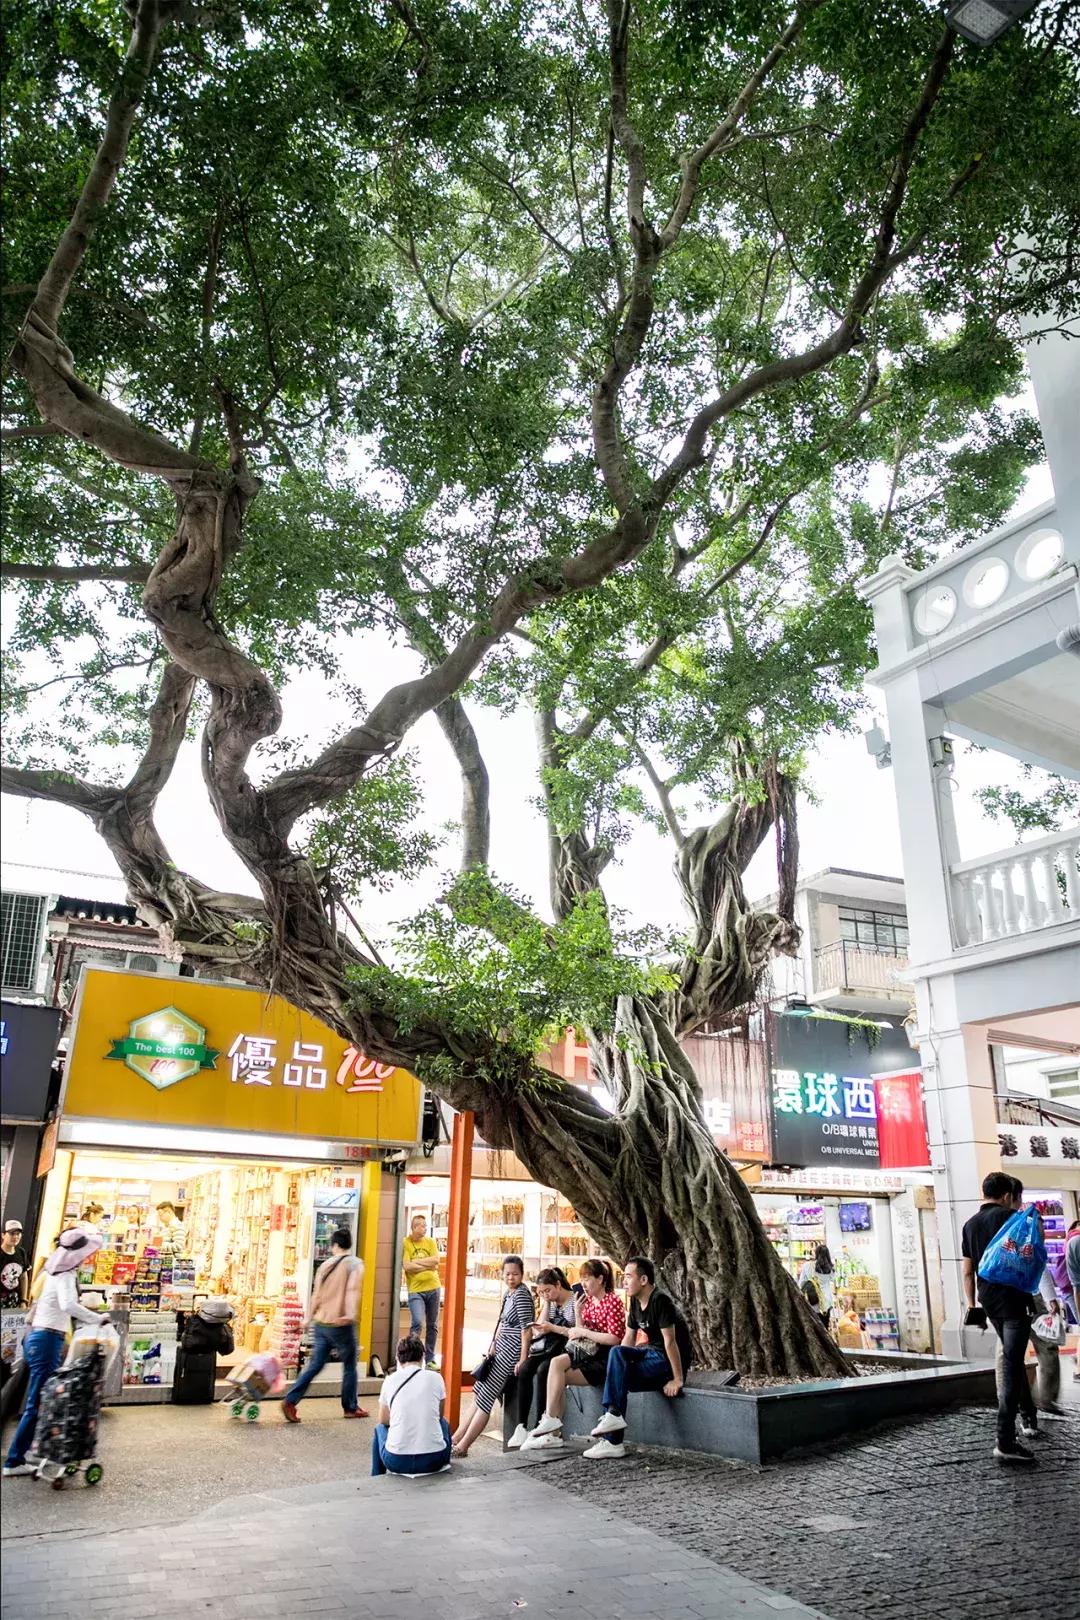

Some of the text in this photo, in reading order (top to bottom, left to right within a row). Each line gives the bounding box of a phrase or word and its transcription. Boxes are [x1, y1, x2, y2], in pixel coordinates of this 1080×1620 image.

[135, 1042, 195, 1056] The best 100
[227, 1033, 327, 1089] 優品
[832, 1147, 864, 1156] UNIVERSAL
